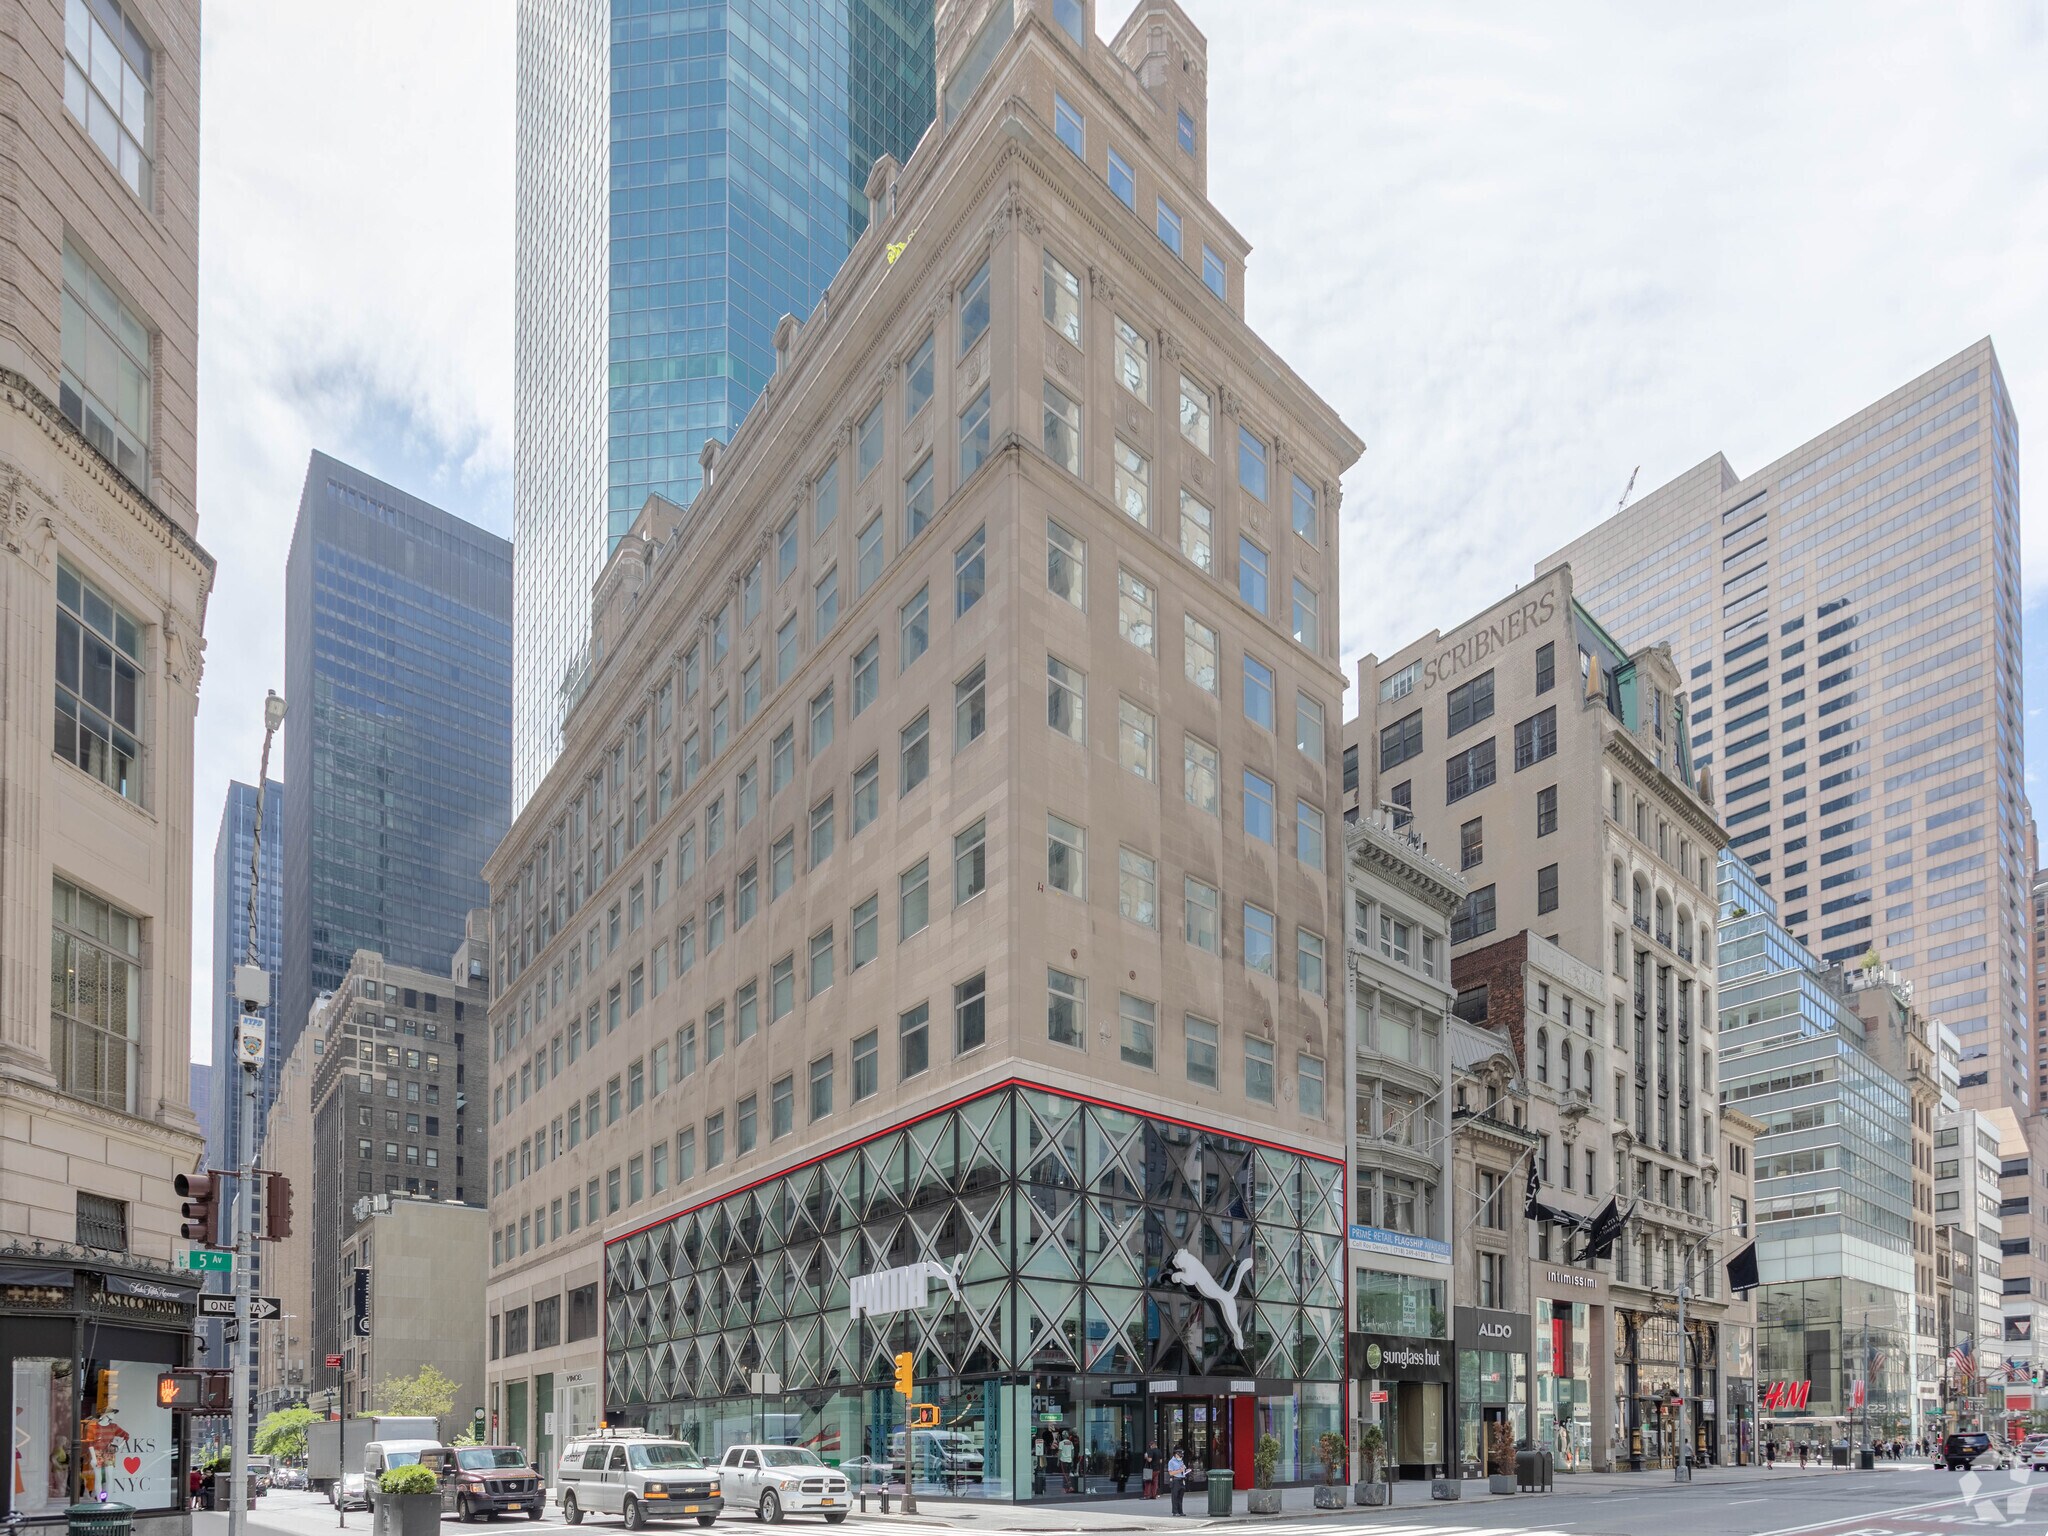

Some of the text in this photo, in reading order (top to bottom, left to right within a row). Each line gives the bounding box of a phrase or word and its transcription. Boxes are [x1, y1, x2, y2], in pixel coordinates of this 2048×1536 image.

[1424, 589, 1555, 691] SCRIBNERS
[243, 1017, 263, 1027] NYPD
[1525, 1165, 1539, 1212] ALD
[1352, 1228, 1449, 1254] PRIME RETAIL FLAGSHIP AVAILABLE
[199, 1253, 223, 1268] 5 Av
[1547, 1271, 1597, 1289] intimissimi
[91, 1292, 119, 1306] SAKS
[850, 1262, 928, 1319] PUMA
[210, 1301, 235, 1312] ONE
[1478, 1323, 1512, 1338] ALDO
[1383, 1347, 1441, 1369] sunglass hut
[1763, 1380, 1811, 1411] H&M
[108, 1438, 156, 1454] SAKS
[112, 1477, 151, 1494] NYC
